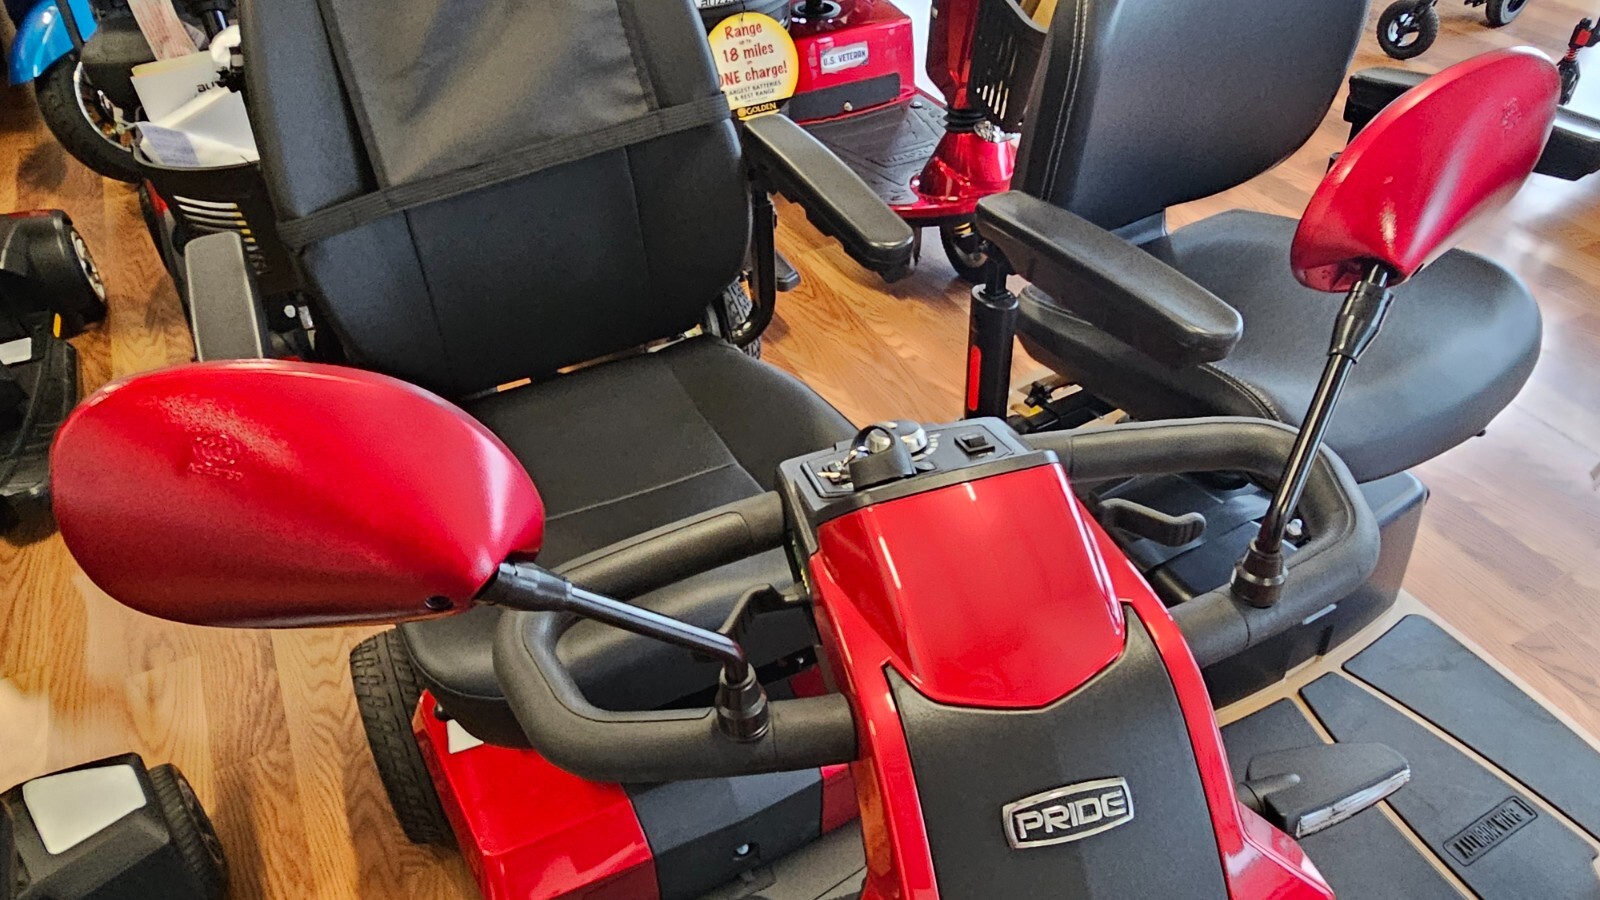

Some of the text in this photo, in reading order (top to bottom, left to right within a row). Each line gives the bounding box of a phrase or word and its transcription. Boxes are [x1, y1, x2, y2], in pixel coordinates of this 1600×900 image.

[724, 23, 763, 40] Range
[723, 42, 774, 63] 18 miles
[823, 50, 866, 66] U.S. VETERAN
[745, 60, 788, 79] charge!
[729, 80, 782, 96] ARGEST BATTERIES
[740, 92, 754, 100] BEST
[755, 88, 775, 97] RANGE
[746, 102, 777, 115] GOLDEN
[1014, 789, 1127, 840] PRIDE
